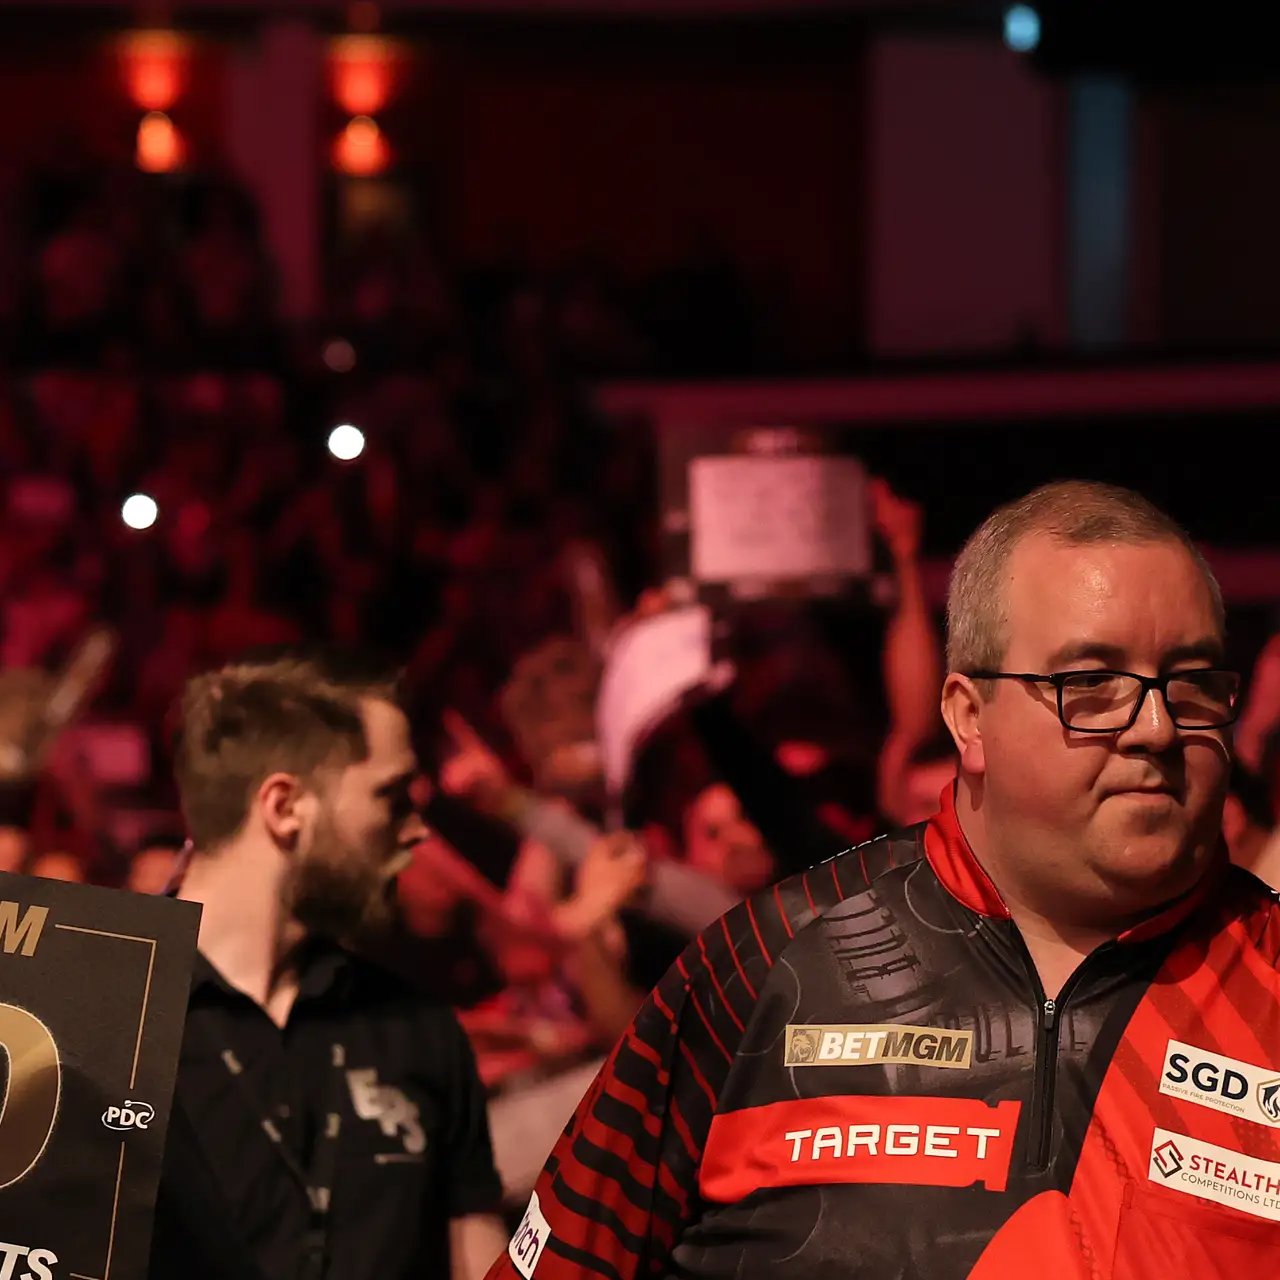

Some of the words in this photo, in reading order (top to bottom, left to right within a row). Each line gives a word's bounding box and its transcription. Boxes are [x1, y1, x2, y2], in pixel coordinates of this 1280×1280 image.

[819, 1031, 969, 1063] BETMGM
[1165, 1053, 1249, 1100] SGD
[102, 1103, 155, 1131] PDC
[785, 1124, 1000, 1162] TARGET
[1181, 1172, 1260, 1204] COMPETITIONS
